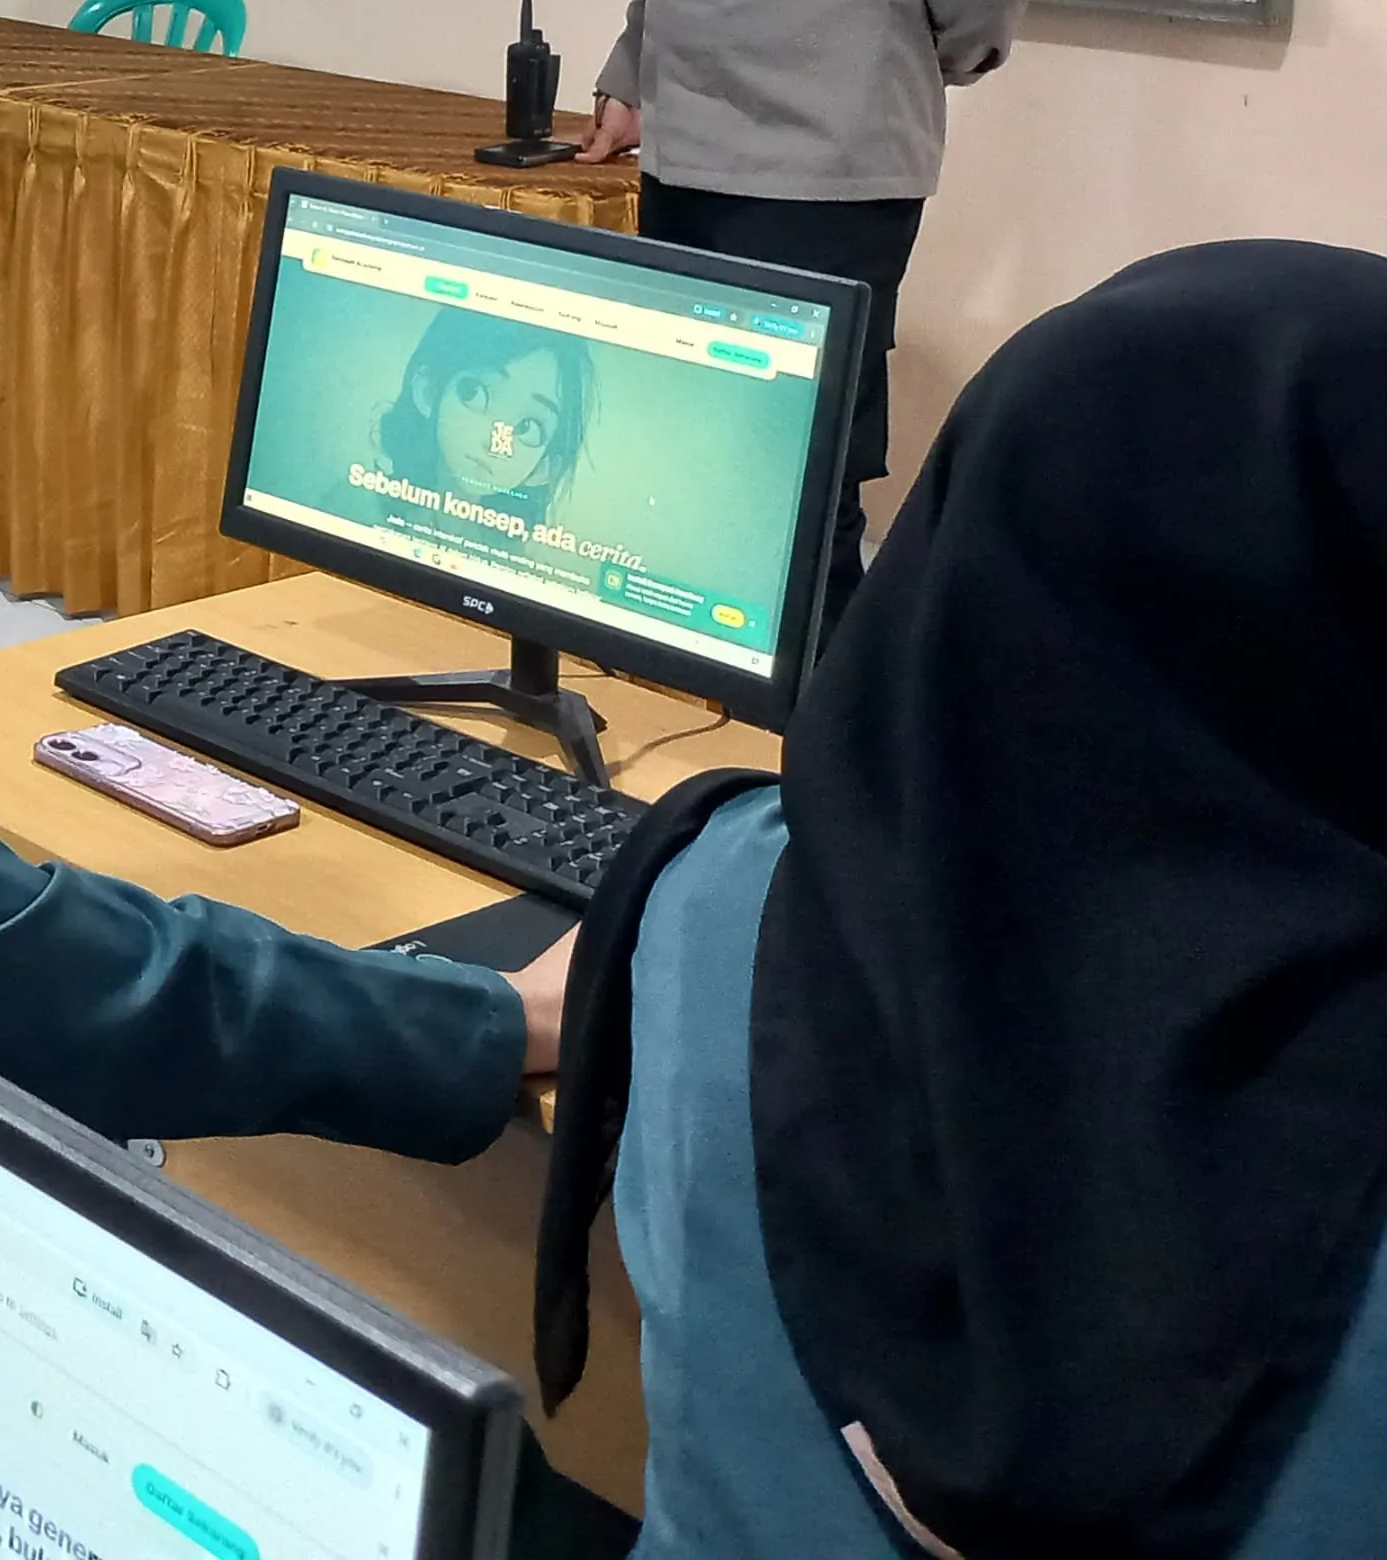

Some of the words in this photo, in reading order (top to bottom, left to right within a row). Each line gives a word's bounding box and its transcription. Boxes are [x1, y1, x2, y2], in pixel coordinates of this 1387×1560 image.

[490, 418, 514, 440] JE
[489, 434, 515, 459] DA
[346, 462, 441, 511] Sebelum
[442, 491, 531, 542] konsep,
[531, 518, 578, 552] ada
[578, 533, 649, 575] cerita.
[462, 595, 490, 614] SPC
